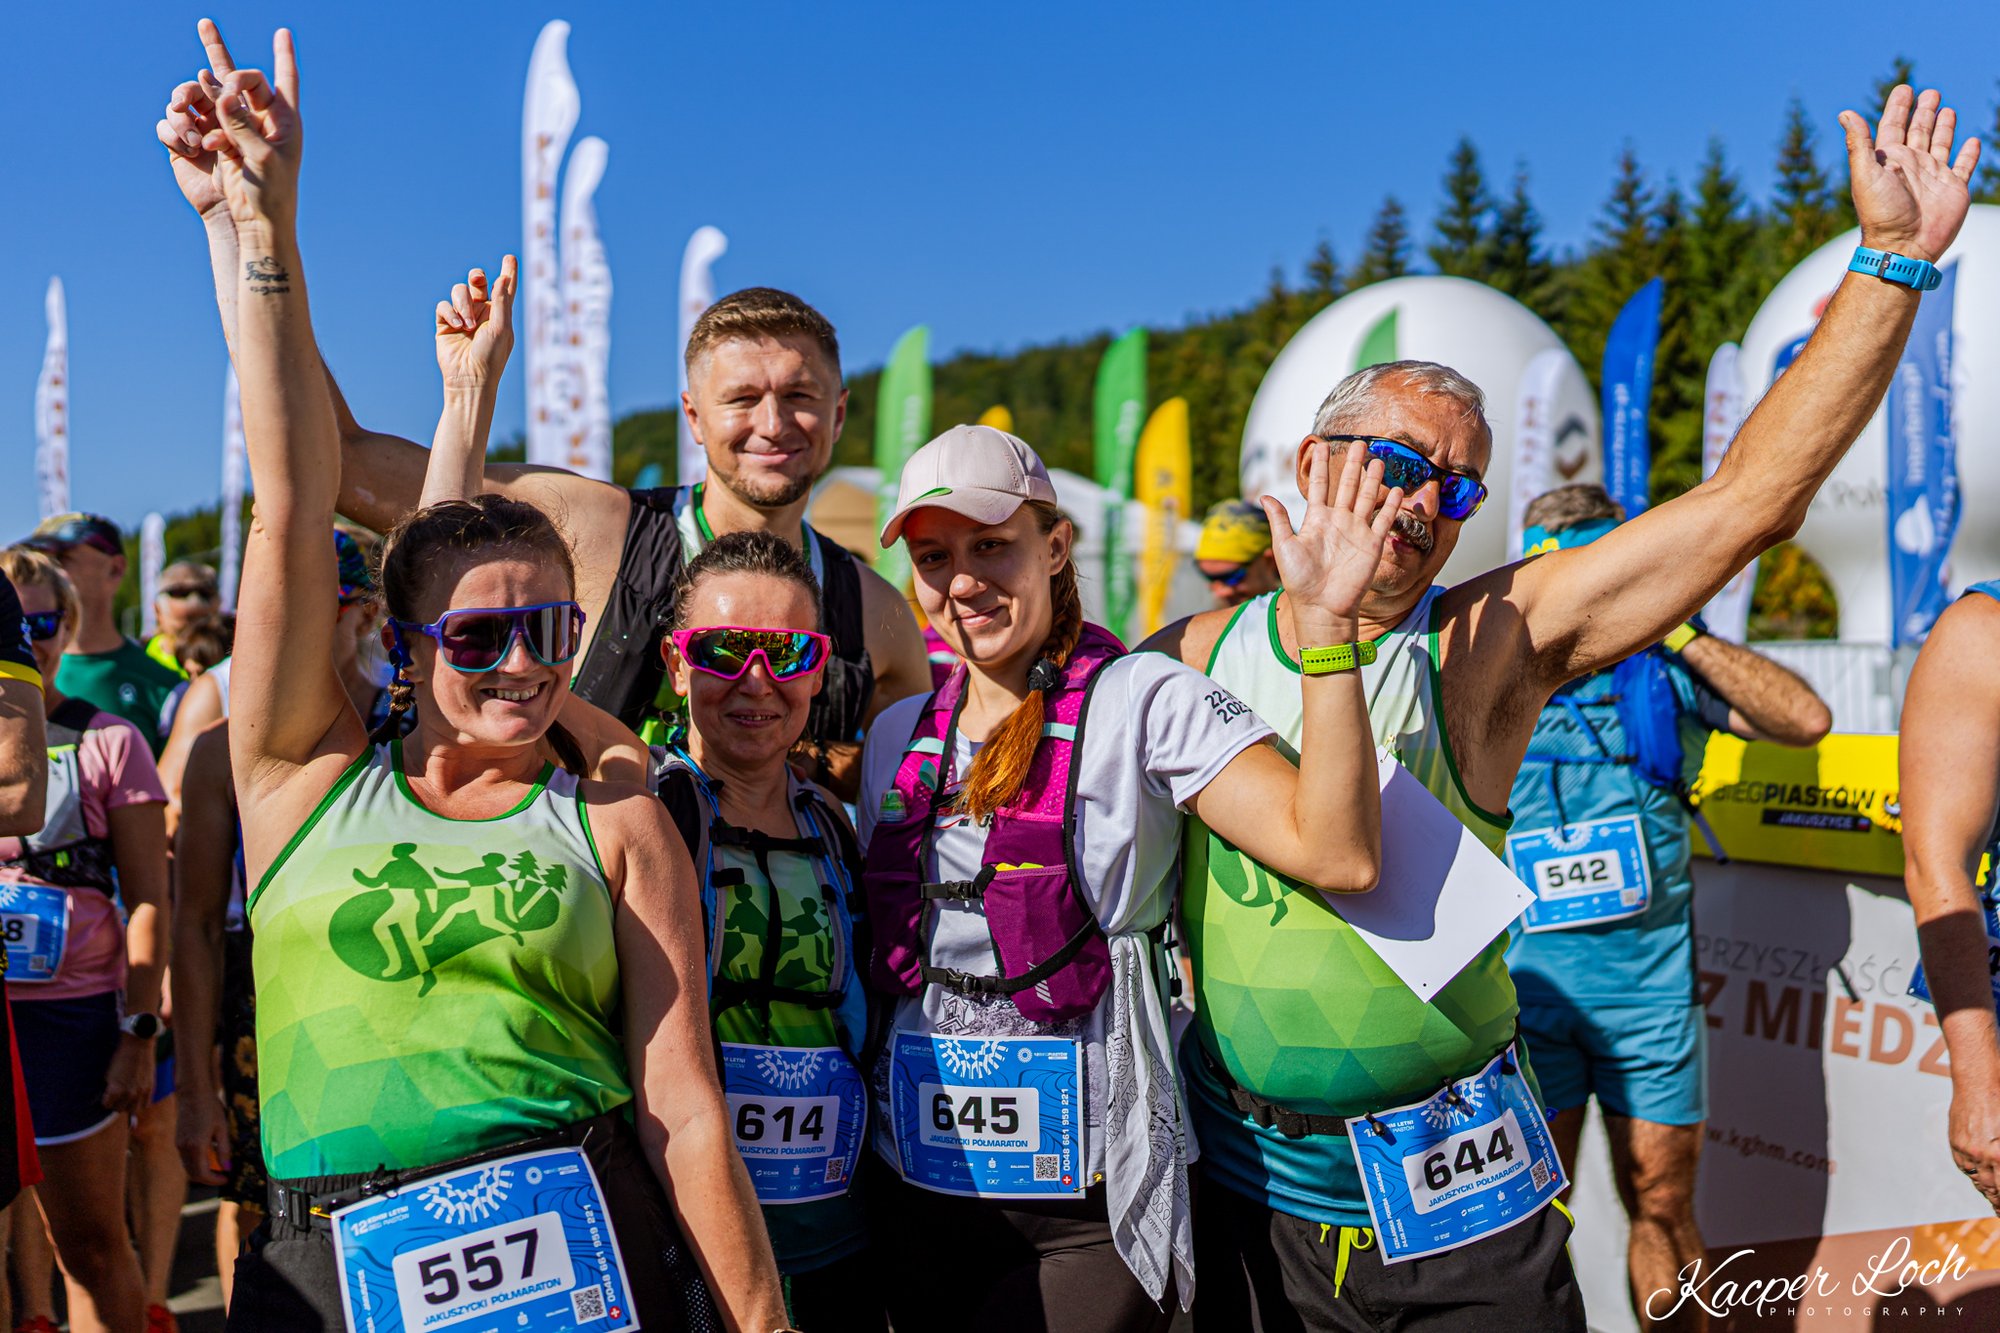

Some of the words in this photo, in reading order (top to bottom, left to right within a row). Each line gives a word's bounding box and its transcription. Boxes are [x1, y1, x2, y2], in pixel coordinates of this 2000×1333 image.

[1546, 858, 1609, 888] 542
[1697, 934, 1903, 997] PRZYSZŁOŚĆ
[1697, 970, 1725, 1031] Z
[1743, 975, 1953, 1079] MIEDZ
[736, 1103, 824, 1143] 614
[932, 1093, 1019, 1134] 645
[1062, 1108, 1070, 1125] 959
[737, 1145, 778, 1155] KUSZYCKI
[929, 1136, 970, 1147] JAKUSZYCKI
[972, 1138, 1028, 1148] PÓŁMARATON
[1062, 1128, 1070, 1145] 661
[1706, 1126, 1837, 1176] w.kghm.com
[1062, 1149, 1071, 1172] 0048
[1423, 1125, 1515, 1192] 644
[1428, 1182, 1475, 1208] JAKUSZYCKI
[1475, 1158, 1526, 1188] PÓŁMARATON
[350, 1219, 369, 1237] 12
[583, 1203, 596, 1224] 221
[589, 1226, 603, 1248] 959
[418, 1227, 539, 1306] 557
[595, 1250, 609, 1272] 661
[423, 1298, 489, 1326] JAKUSZYCKI
[490, 1276, 562, 1306] PÓŁMARATON
[602, 1273, 615, 1303] 0048
